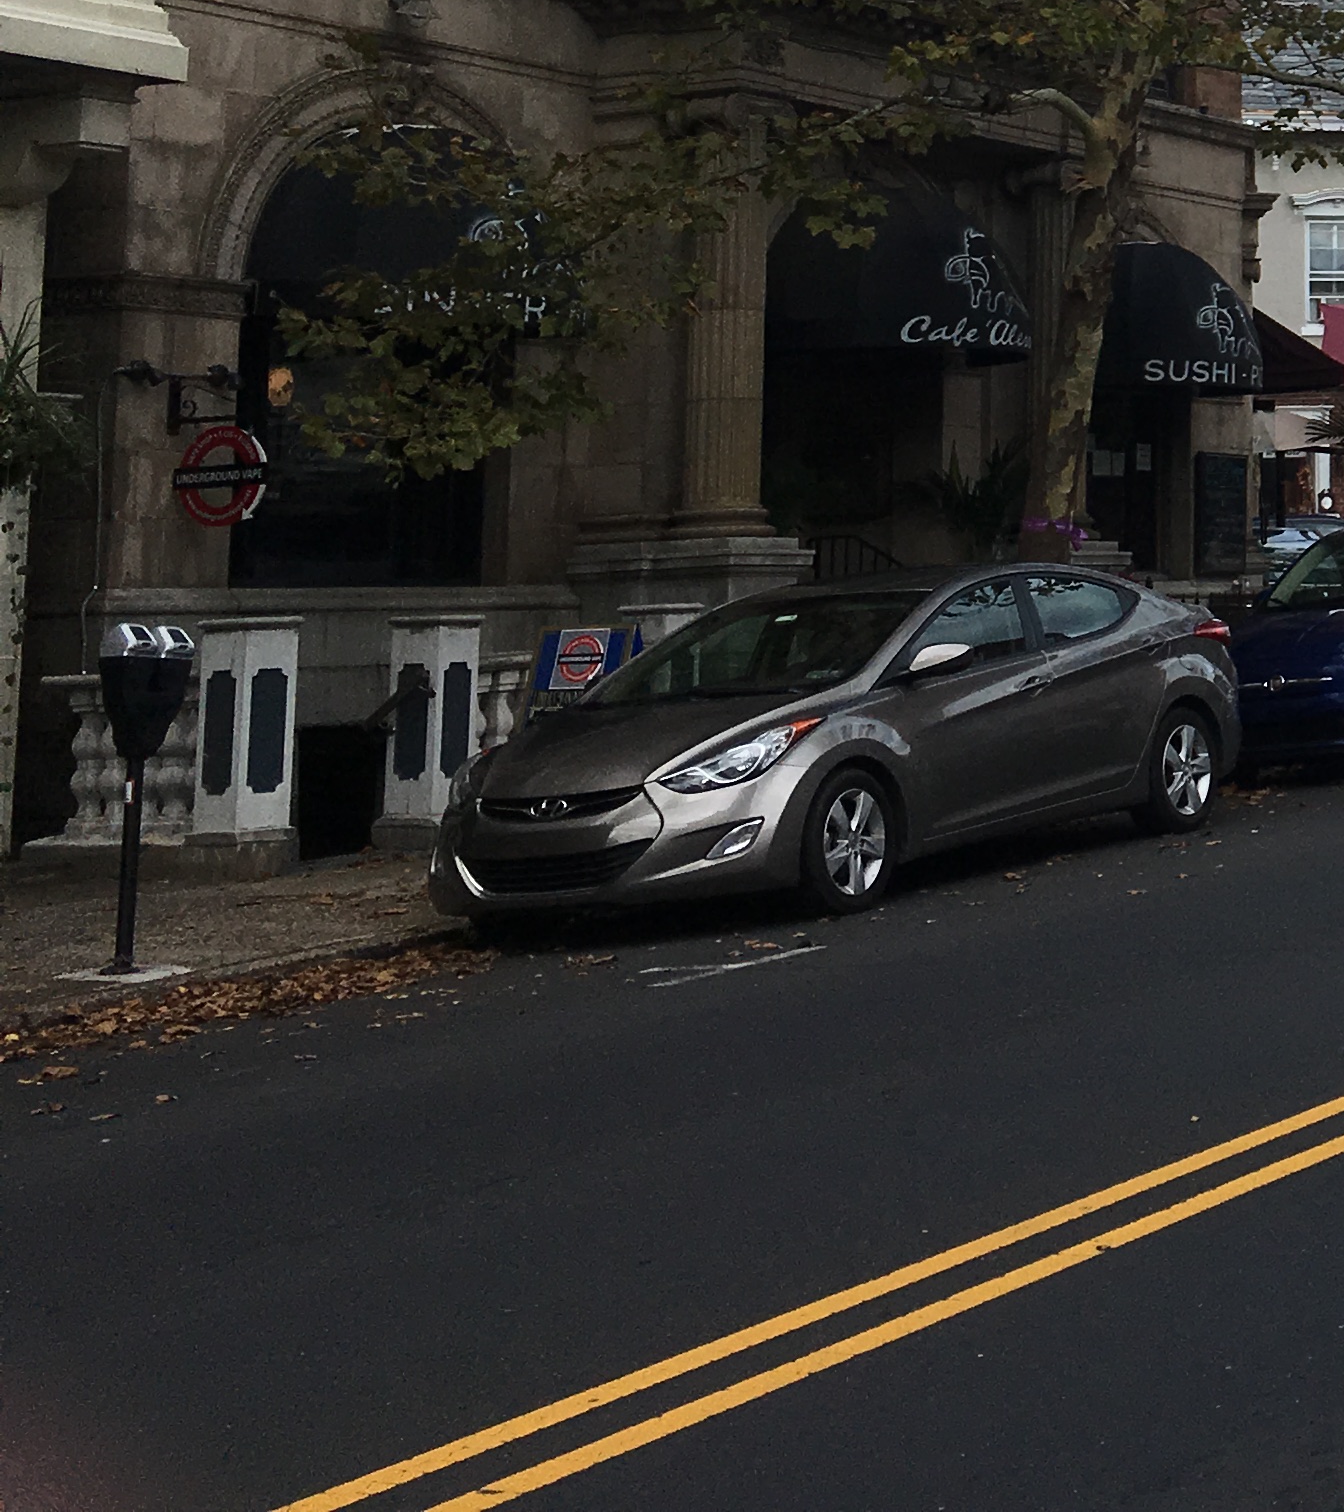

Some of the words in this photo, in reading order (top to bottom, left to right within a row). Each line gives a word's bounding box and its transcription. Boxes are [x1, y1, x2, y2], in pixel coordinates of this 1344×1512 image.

[900, 315, 980, 346] Cafe
[1144, 359, 1236, 384] SUSHI
[176, 470, 240, 485] UNDERGROUND
[242, 468, 262, 479] VAPE
